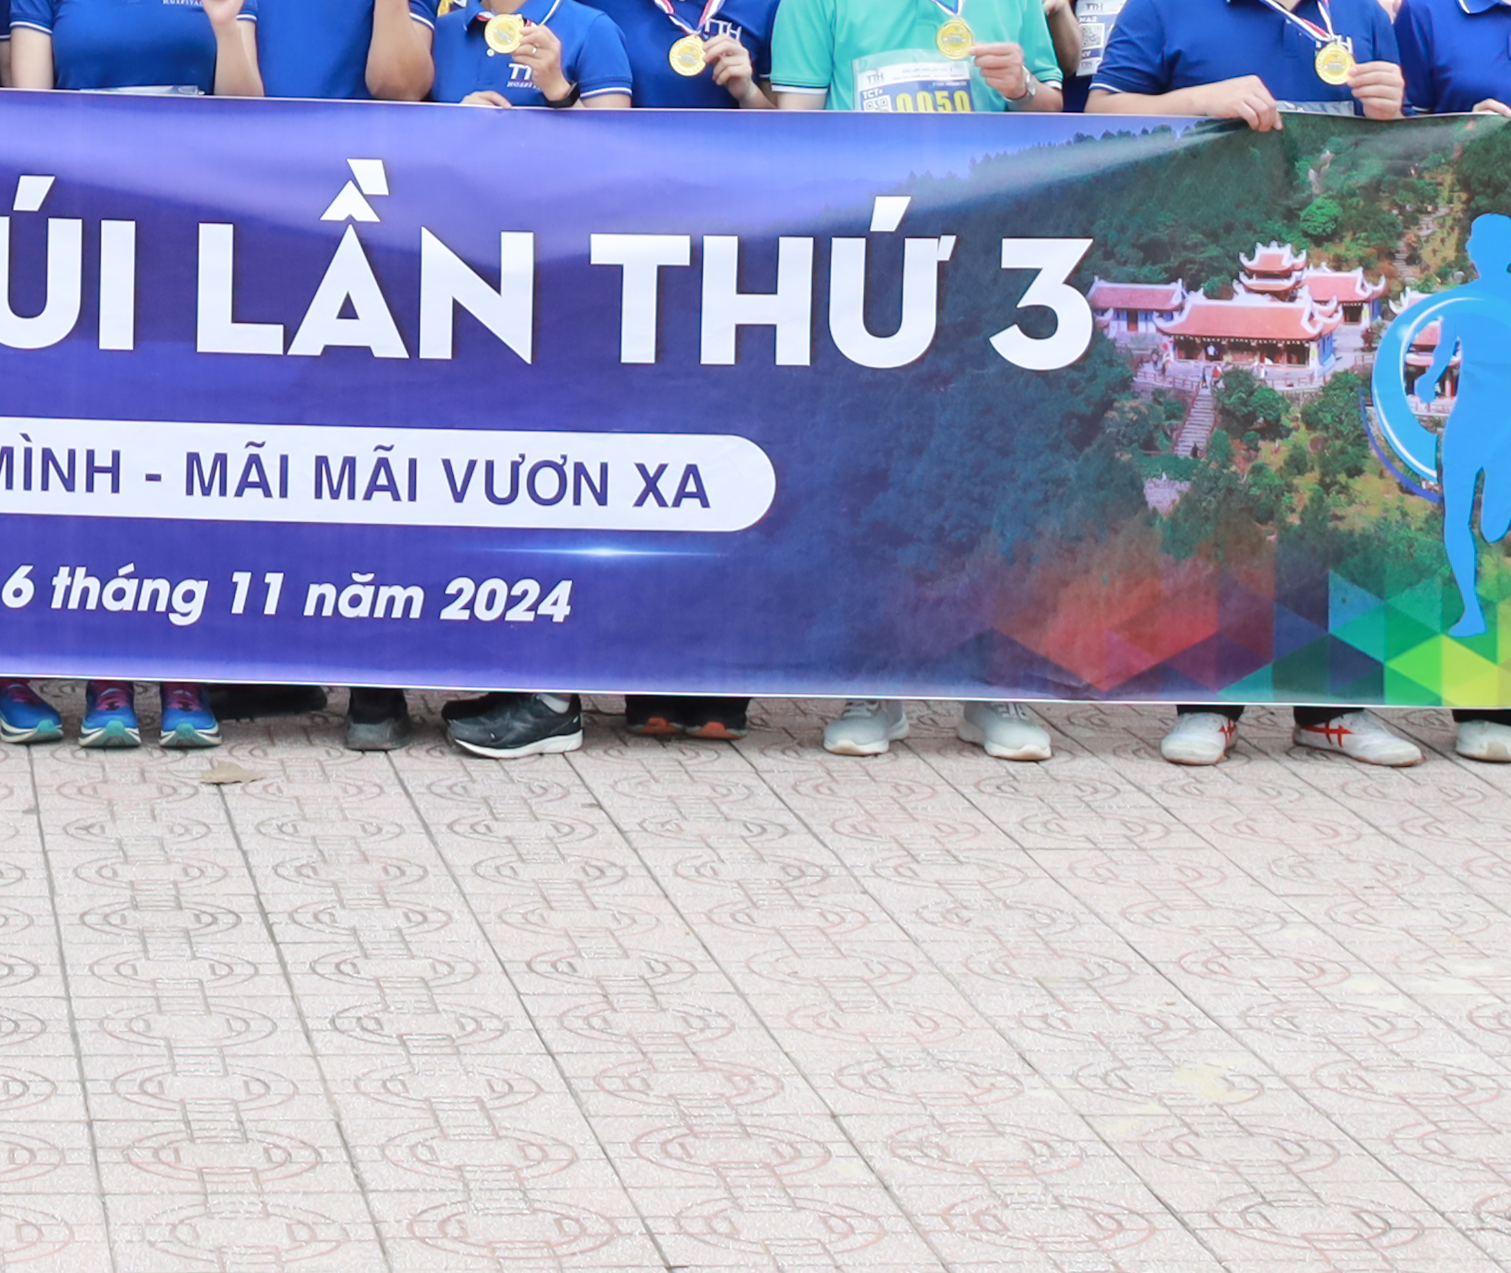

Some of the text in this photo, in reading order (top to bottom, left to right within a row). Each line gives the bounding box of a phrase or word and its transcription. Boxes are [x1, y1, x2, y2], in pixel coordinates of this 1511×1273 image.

[509, 63, 532, 81] TT
[895, 90, 970, 112] 0050
[196, 158, 534, 364] LẦN
[590, 196, 956, 369] THỨ
[989, 238, 1094, 371] 3
[185, 440, 289, 499] MÃI
[314, 444, 418, 502] MÃI
[440, 453, 609, 508] VƯƠN
[634, 462, 711, 509] XA
[51, 564, 209, 626] tháng
[230, 570, 284, 616] 11
[303, 572, 426, 621] năm
[439, 577, 573, 624] 2024
